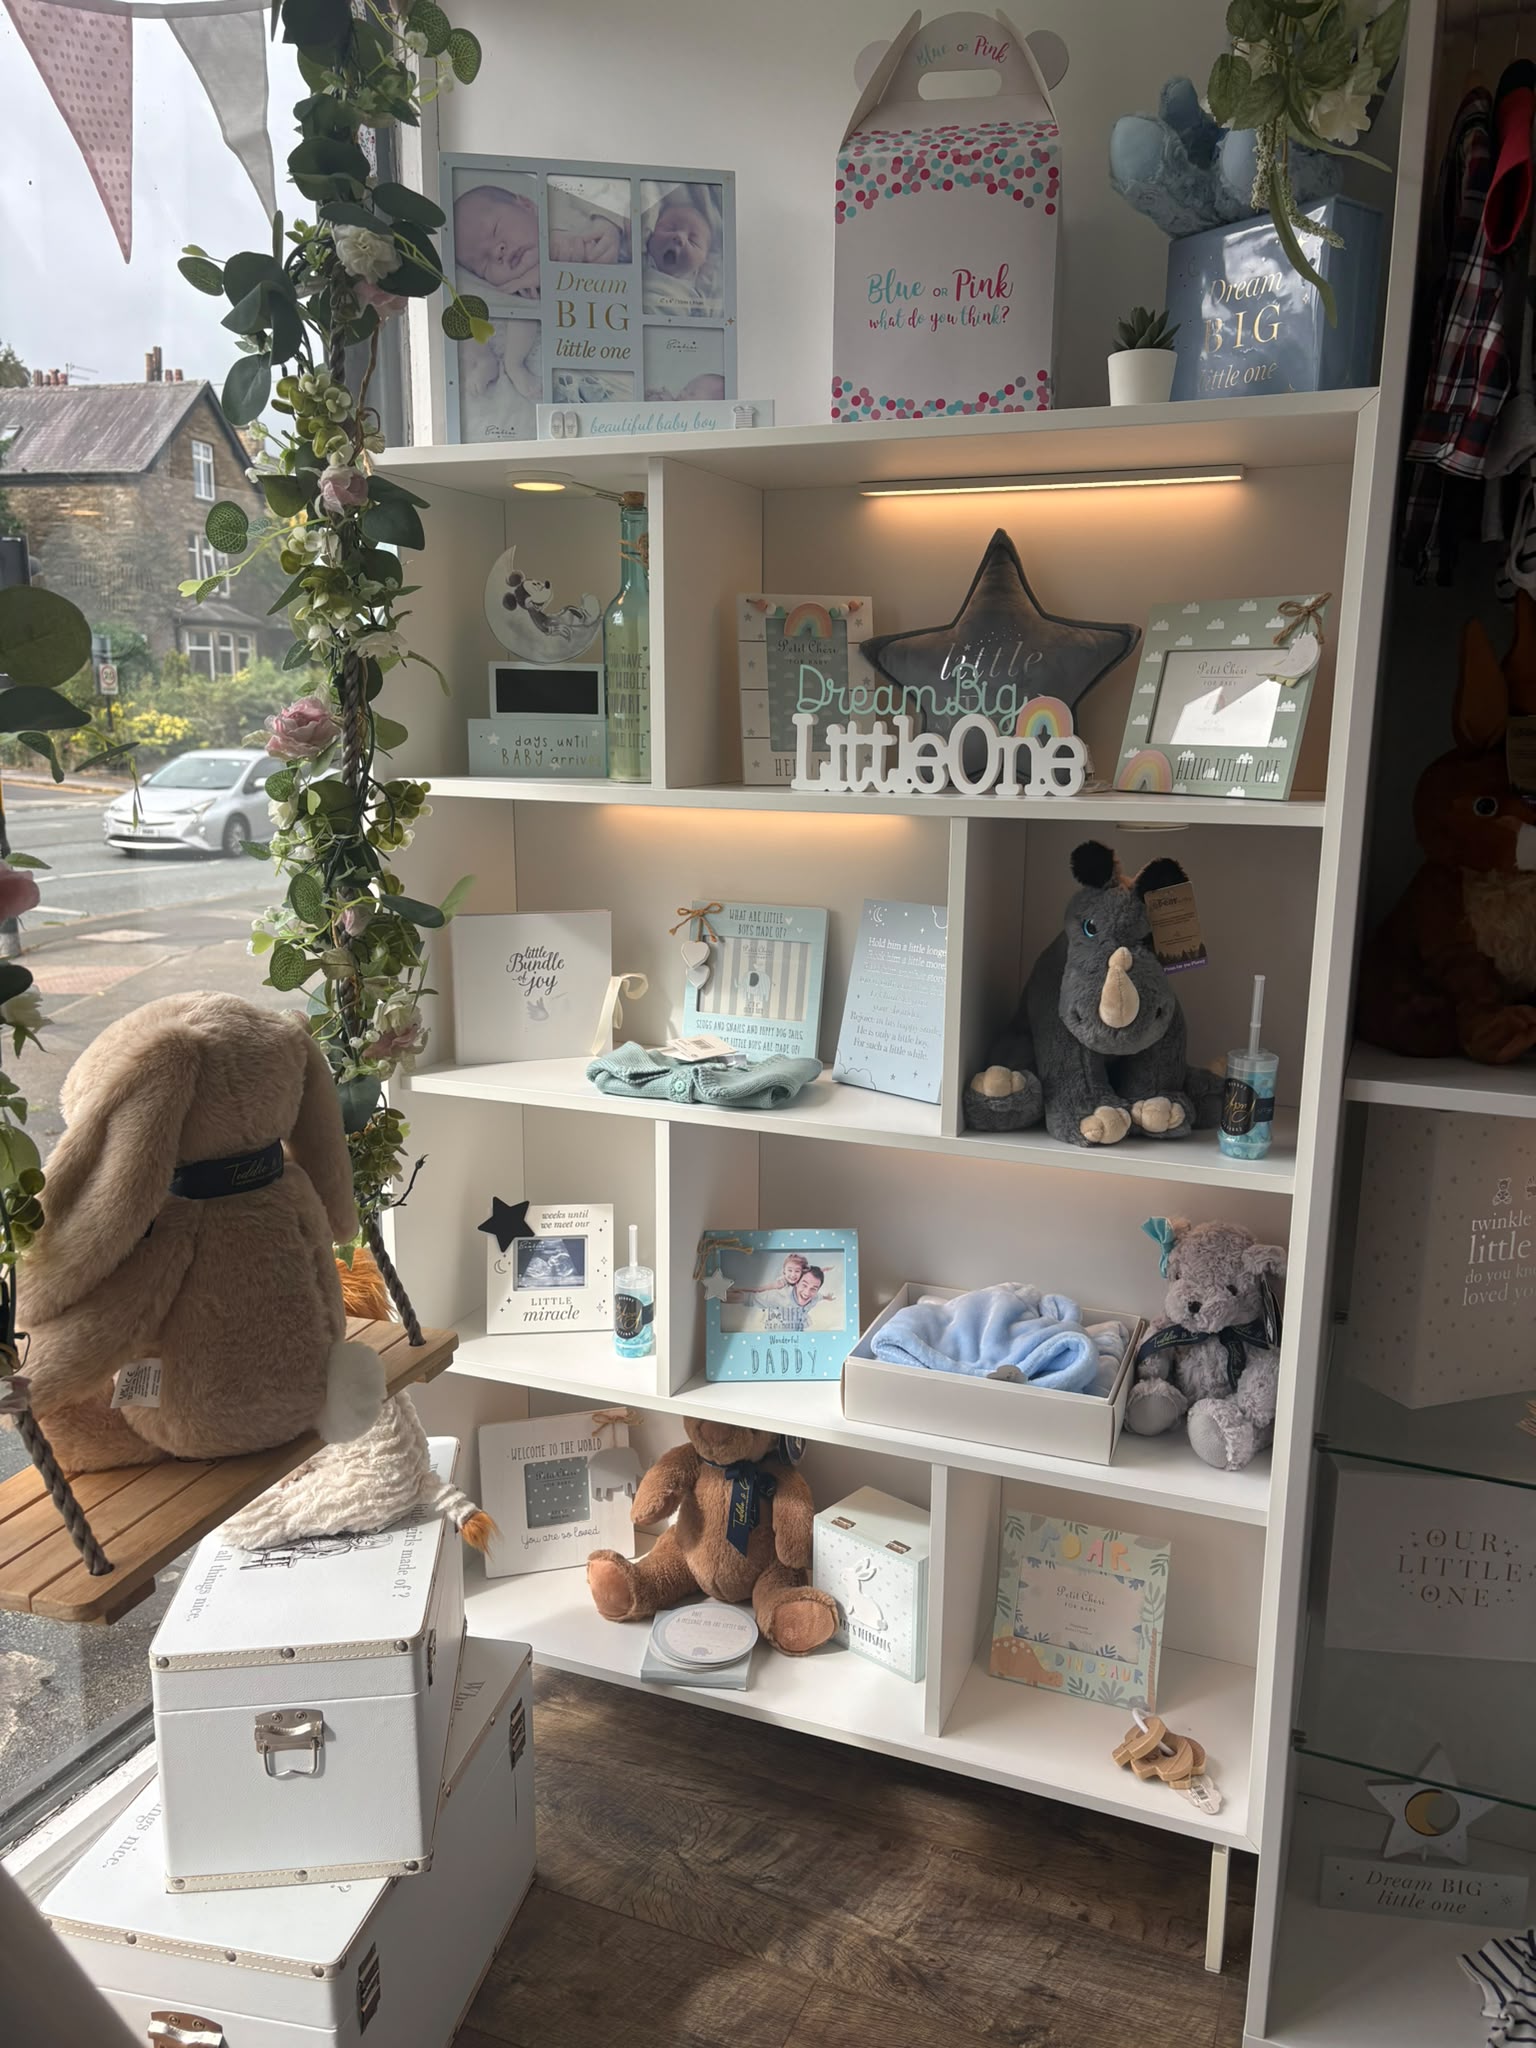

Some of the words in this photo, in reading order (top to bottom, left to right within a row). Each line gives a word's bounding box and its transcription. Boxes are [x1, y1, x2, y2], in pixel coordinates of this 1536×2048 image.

[973, 34, 1010, 65] Pink
[556, 270, 628, 294] Dream
[866, 267, 926, 305] Blue
[932, 287, 949, 297] OR
[951, 263, 1015, 303] Pink
[1208, 271, 1284, 305] Dream
[556, 299, 631, 332] BIG
[868, 307, 905, 330] what
[907, 307, 926, 329] do
[929, 311, 958, 332] you
[960, 304, 1011, 327] think?
[1203, 303, 1283, 353] BIG
[555, 338, 597, 359] little
[599, 345, 631, 360] one
[1243, 361, 1280, 384] one
[590, 413, 655, 435] beautiful
[656, 411, 688, 432] baby
[693, 411, 717, 430] boy
[796, 663, 949, 716] Dream
[945, 662, 1028, 737] Big
[514, 735, 548, 749] days
[501, 747, 543, 767] BABY
[1175, 757, 1211, 780] HELLO
[1212, 758, 1252, 783] LITTLE
[1254, 759, 1281, 784] ONE
[729, 908, 747, 921] WHAT
[748, 910, 761, 922] ARE
[763, 911, 784, 924] LITTLE
[738, 923, 754, 936] BOYS
[755, 925, 773, 938] MADE
[523, 945, 549, 960] little
[867, 936, 886, 948] Hold
[886, 938, 902, 951] him
[907, 942, 926, 954] little
[505, 951, 565, 974] Bundle
[518, 971, 558, 997] joy
[713, 1020, 725, 1032] AND
[746, 1024, 759, 1035] AND
[540, 1221, 553, 1229] we
[554, 1220, 573, 1229] meet
[574, 1220, 591, 1228] our
[541, 1210, 566, 1220] weeks
[567, 1209, 590, 1219] until
[1471, 1209, 1532, 1232] twinkle
[1467, 1231, 1532, 1265] little
[1465, 1269, 1483, 1284] do
[1486, 1269, 1511, 1289] you
[531, 1296, 573, 1307] LITTLE
[1462, 1283, 1509, 1306] loved
[522, 1305, 581, 1322] miracle
[769, 1335, 800, 1345] Wonderful
[751, 1348, 818, 1375] DADDY
[511, 1443, 547, 1461] WELCOME
[549, 1442, 559, 1456] TO
[560, 1440, 575, 1455] THE
[577, 1437, 602, 1453] WORLD
[520, 1534, 542, 1550] You
[542, 1532, 561, 1542] are
[561, 1531, 573, 1540] so
[573, 1526, 600, 1539] loved
[1039, 1526, 1132, 1573] ROAR
[1426, 1528, 1498, 1553] OUR
[396, 1549, 417, 1576] made
[1398, 1554, 1523, 1583] LITTLE
[194, 1564, 228, 1595] things
[1420, 1584, 1490, 1608] ONE
[1053, 1652, 1145, 1685] DINOSAUR
[1365, 1870, 1433, 1892] Dream
[1440, 1878, 1483, 1897] BIG
[1376, 1890, 1425, 1909] little
[1430, 1900, 1468, 1915] one
